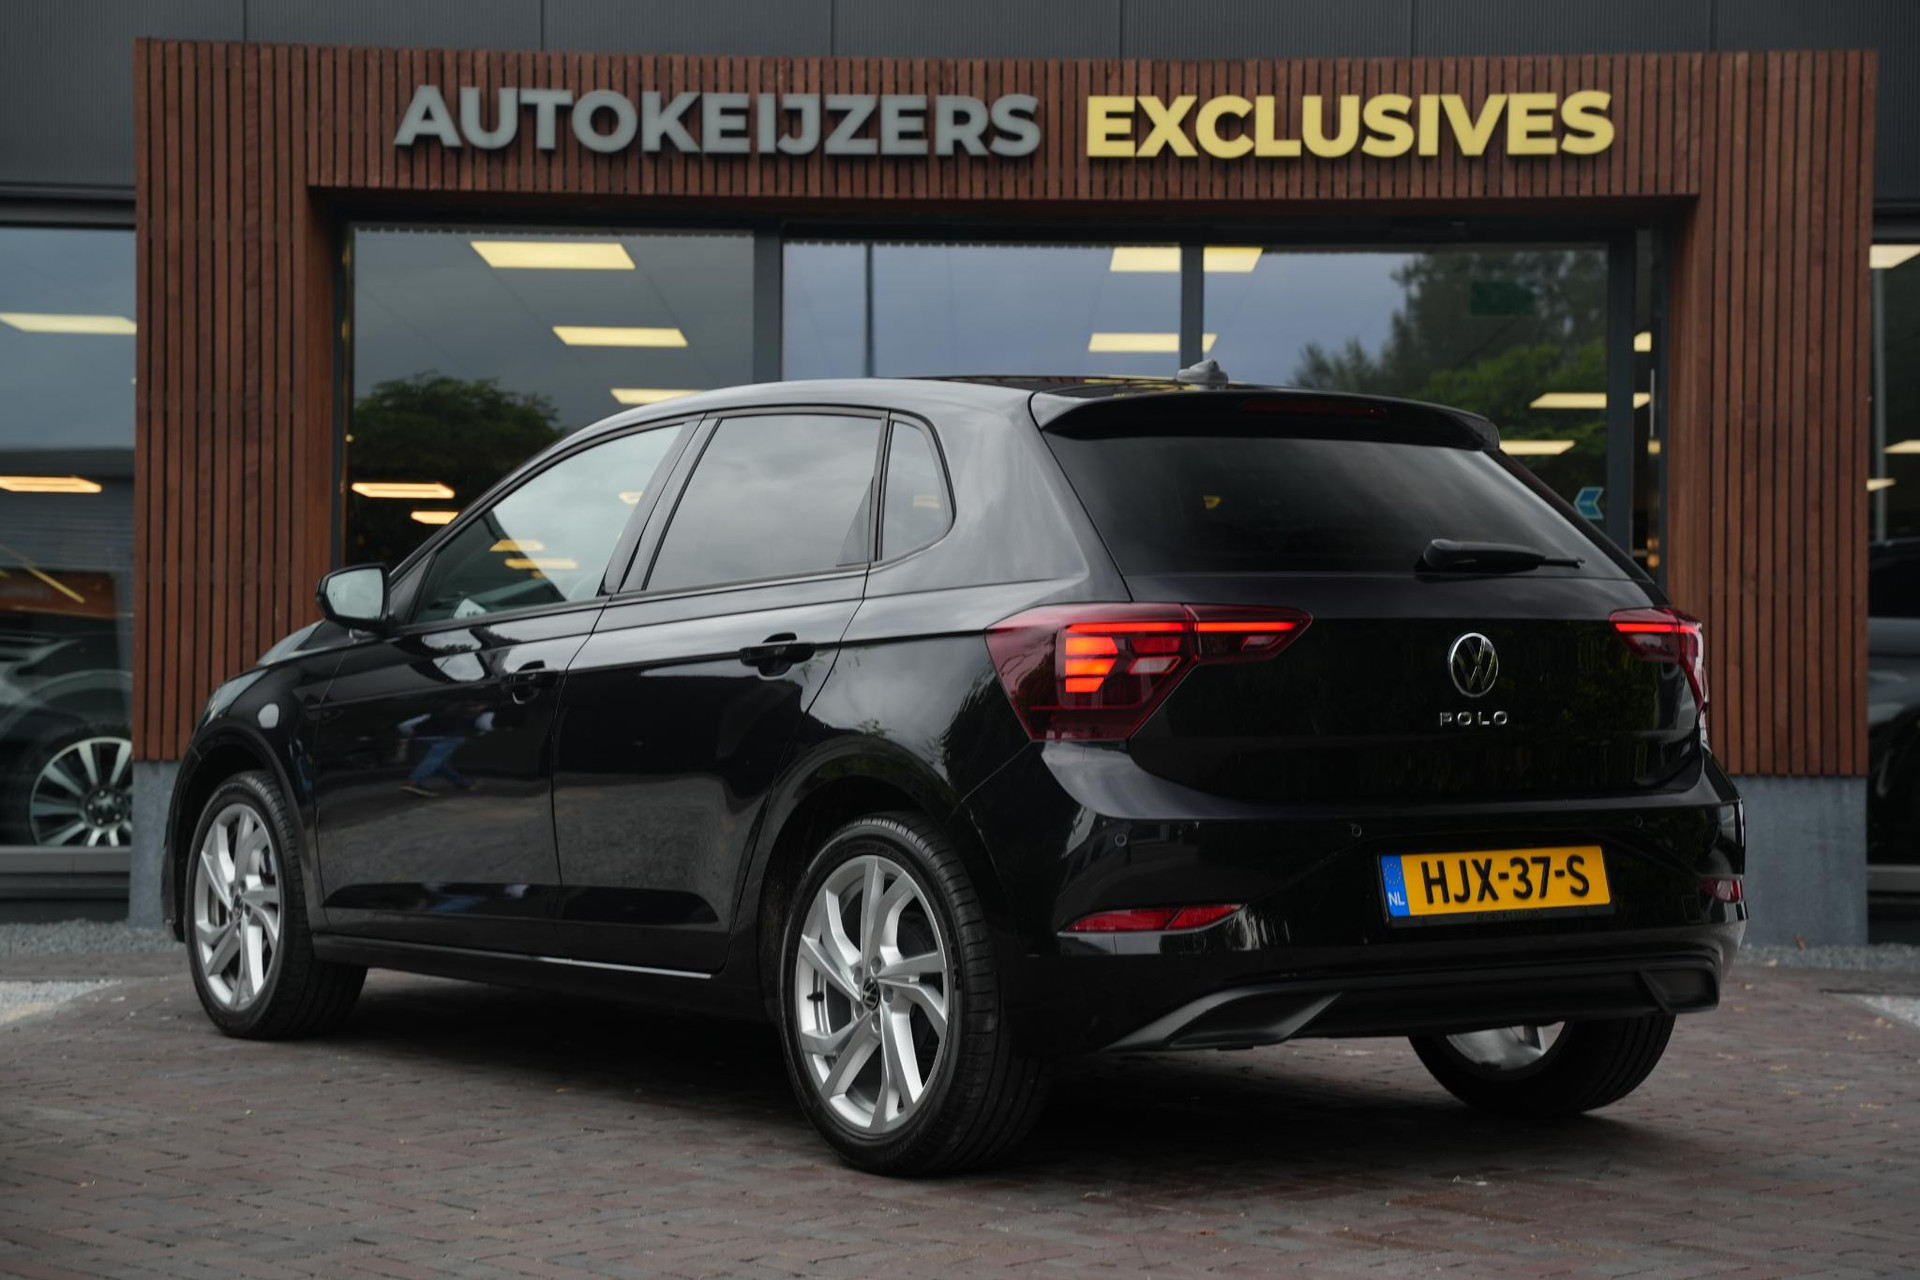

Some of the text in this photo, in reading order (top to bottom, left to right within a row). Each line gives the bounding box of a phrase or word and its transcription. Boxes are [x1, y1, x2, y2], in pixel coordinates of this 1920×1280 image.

[393, 84, 1616, 159] AUTOKEIJZERS EXCLUSIVES
[1439, 710, 1508, 727] POLO
[1420, 854, 1590, 905] HJX-37-S
[1387, 891, 1406, 907] NL
